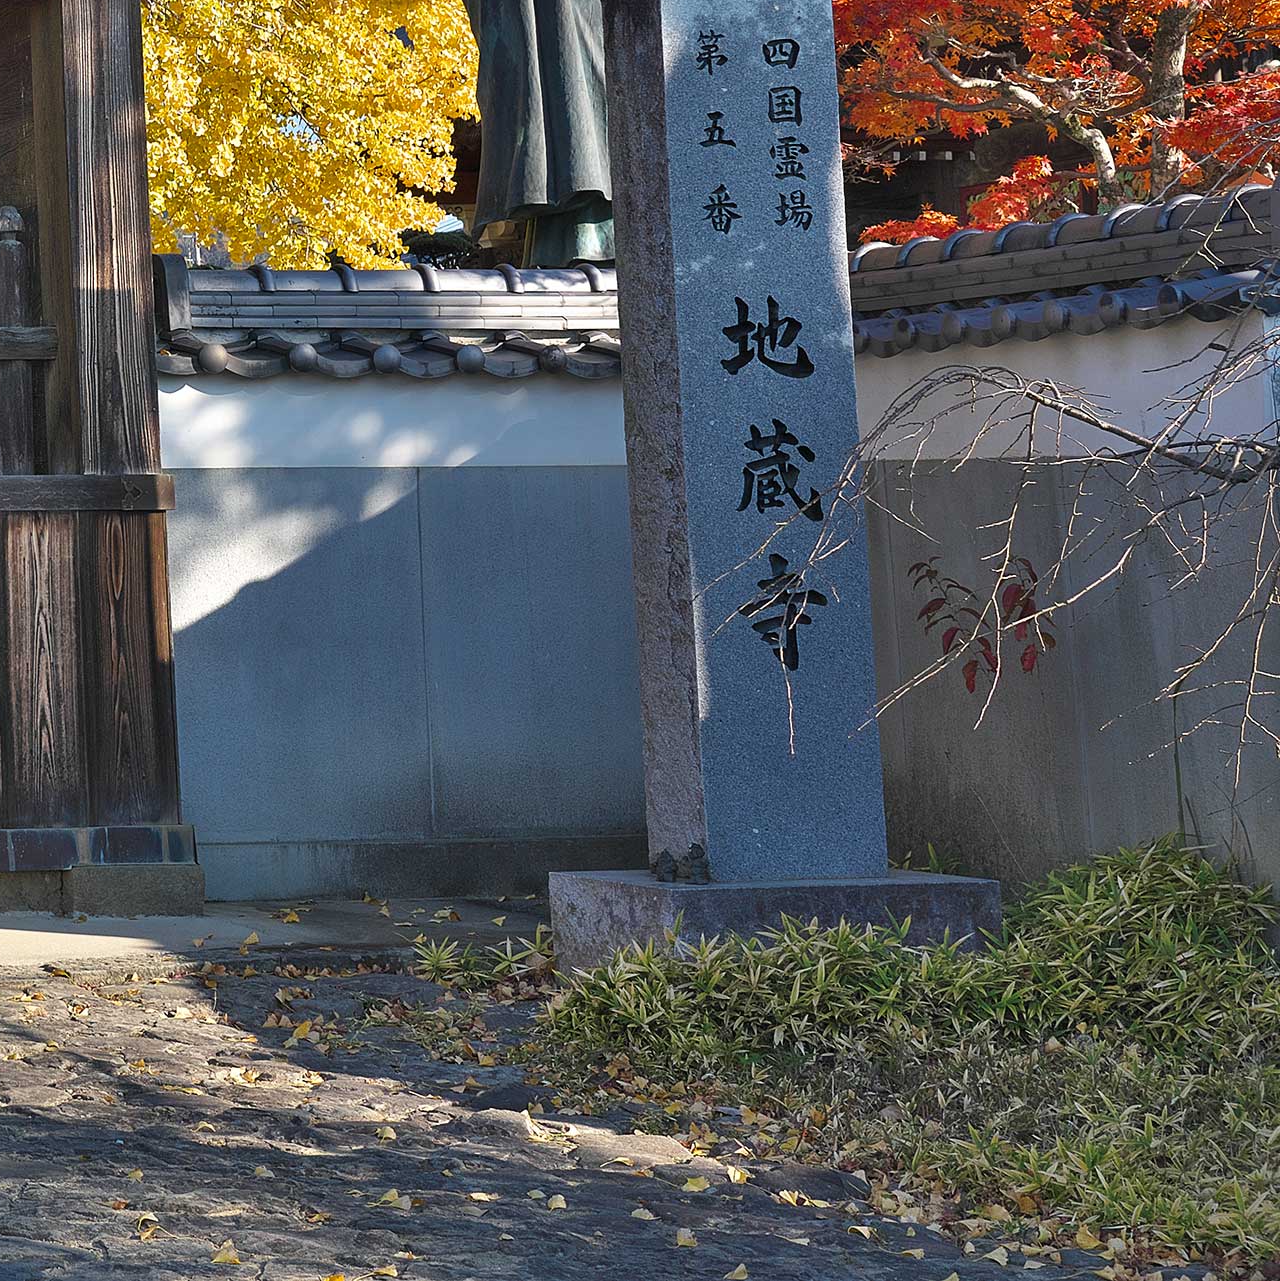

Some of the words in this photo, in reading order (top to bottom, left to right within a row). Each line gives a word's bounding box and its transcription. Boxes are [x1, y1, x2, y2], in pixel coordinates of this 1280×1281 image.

[695, 29, 742, 235] 第五番
[762, 38, 814, 231] 四国霊場
[721, 294, 829, 671] 地蔵寺
